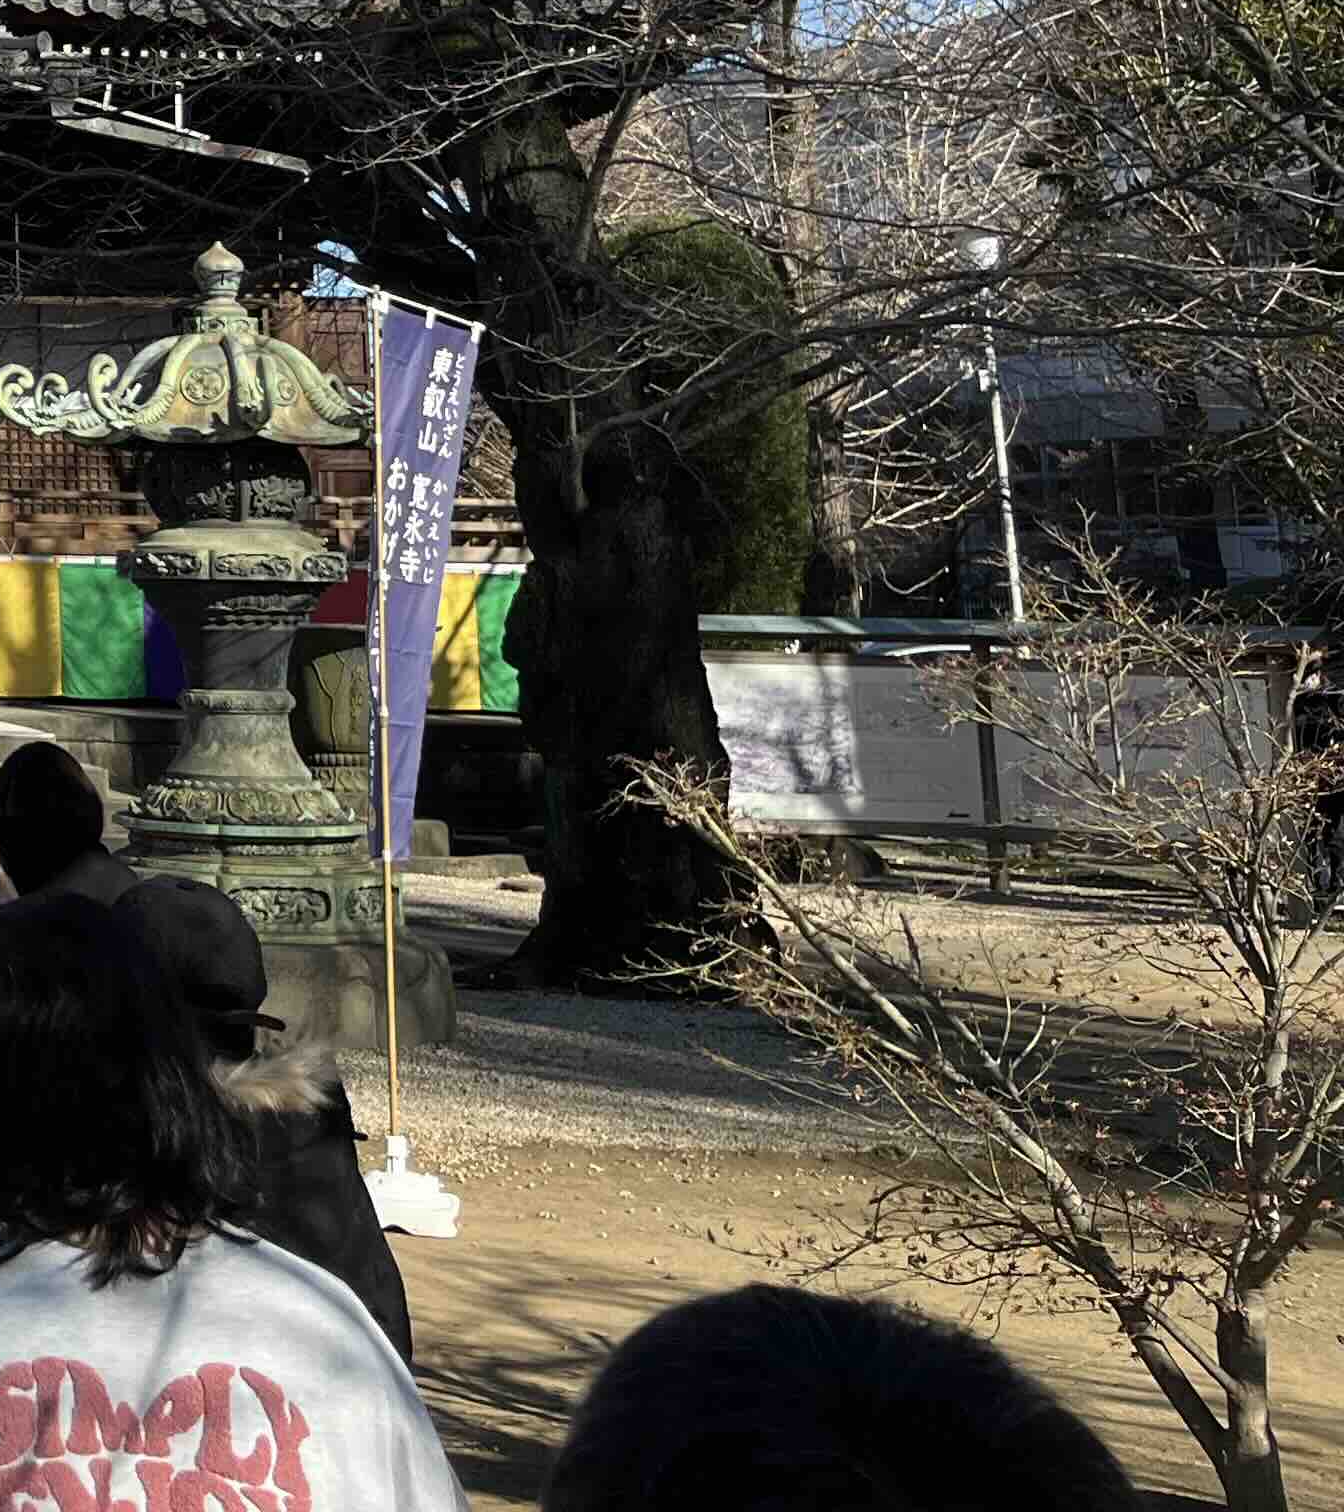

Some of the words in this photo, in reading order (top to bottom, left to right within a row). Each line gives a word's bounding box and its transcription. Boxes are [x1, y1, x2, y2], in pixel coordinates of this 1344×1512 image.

[418, 348, 454, 455] 東叡山
[438, 353, 466, 460] とうえいざん
[399, 473, 432, 584] 寛永寺
[423, 479, 448, 584] かんえいじ
